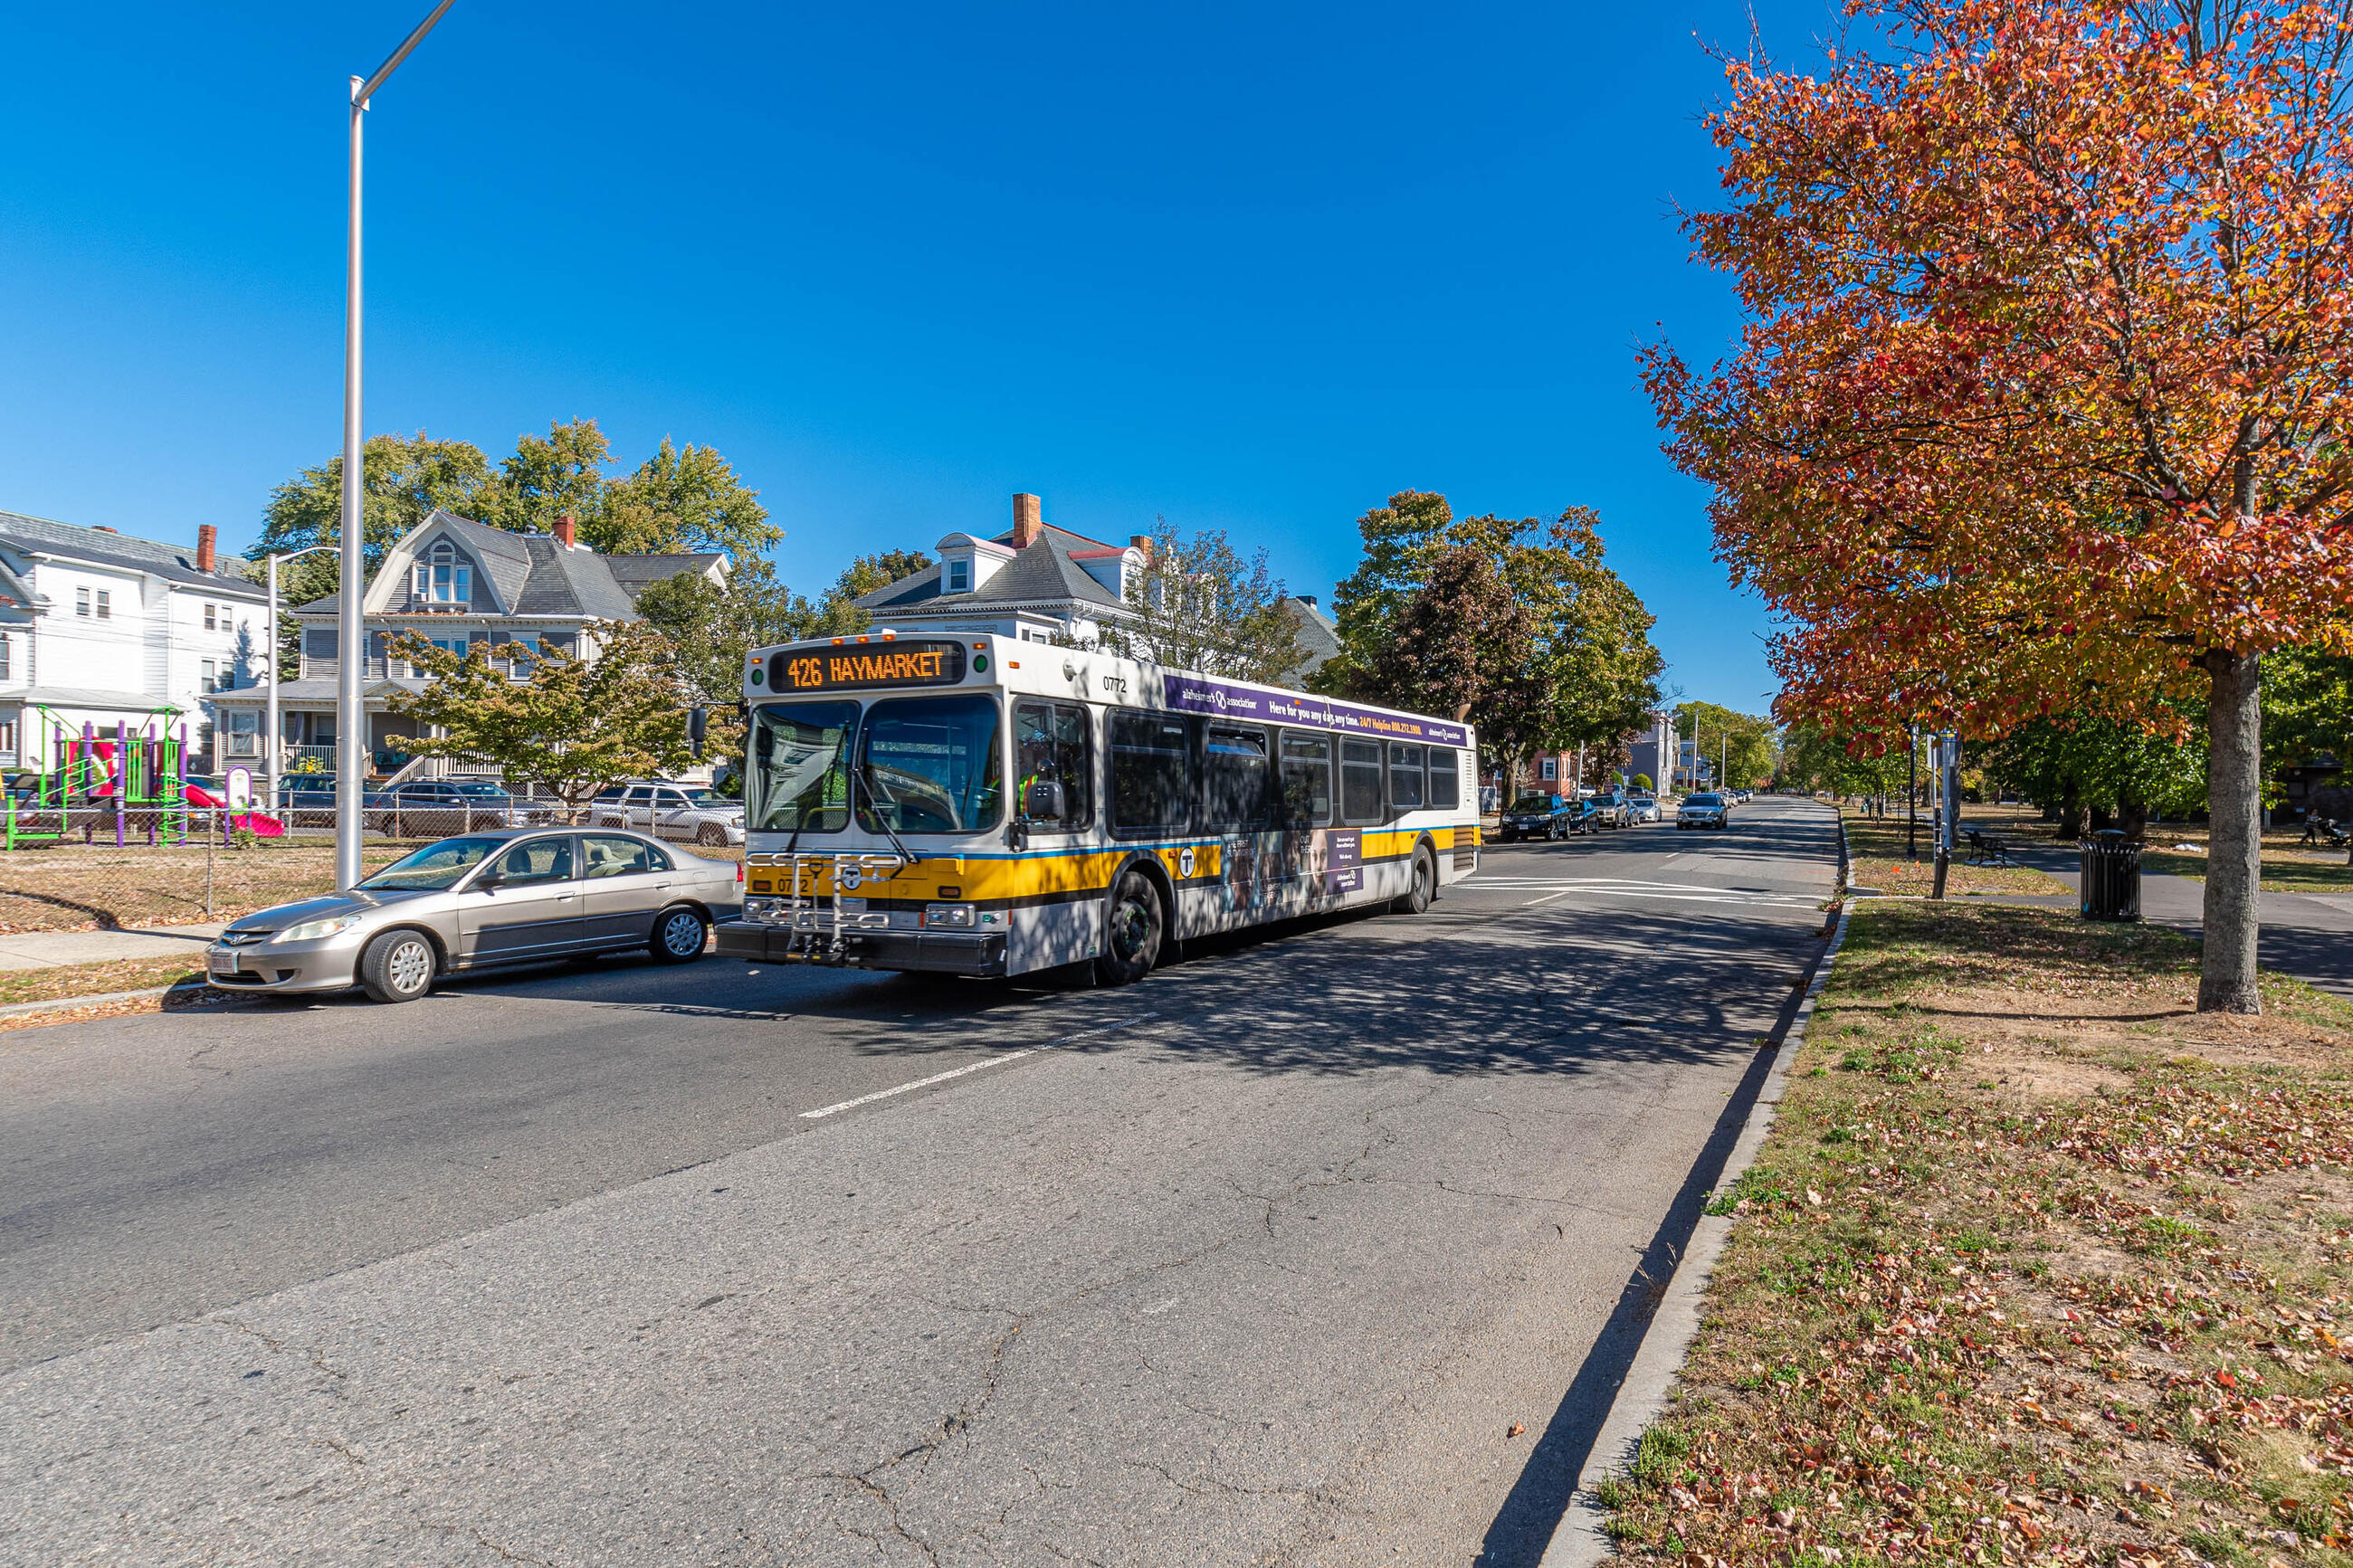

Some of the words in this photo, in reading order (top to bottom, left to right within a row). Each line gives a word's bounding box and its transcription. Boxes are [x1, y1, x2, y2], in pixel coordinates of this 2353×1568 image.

[787, 659, 823, 687] 426
[830, 652, 943, 681] HAYMARKET
[1103, 676, 1127, 693] 0772
[1269, 701, 1286, 715] Here
[1287, 703, 1297, 717] for
[1298, 708, 1310, 721] you
[1310, 711, 1322, 724] any
[1335, 715, 1346, 727] any
[1345, 713, 1359, 726] time.
[1359, 717, 1372, 727] 24/7
[1372, 719, 1392, 733] Helpline
[1182, 855, 1192, 873] T
[778, 879, 808, 892] 072
